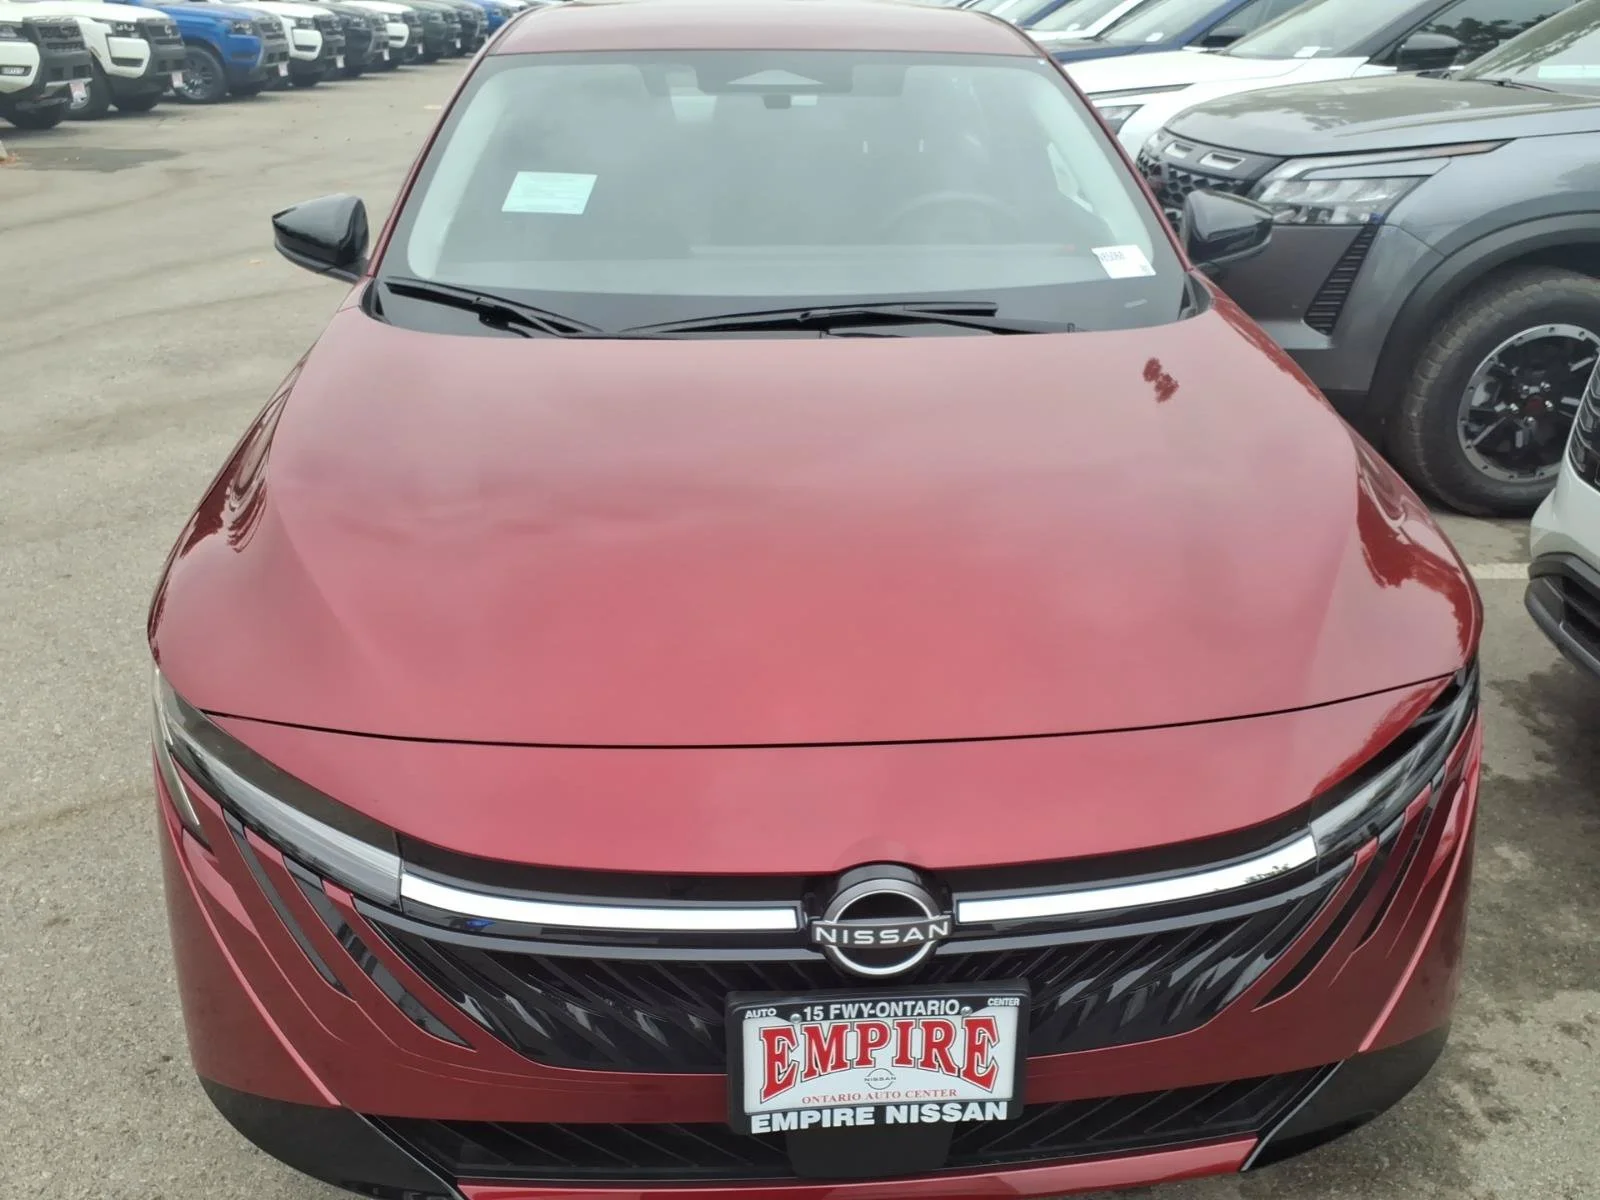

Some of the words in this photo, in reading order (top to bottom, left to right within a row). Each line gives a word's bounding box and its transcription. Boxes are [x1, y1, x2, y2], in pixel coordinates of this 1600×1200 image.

[816, 921, 949, 944] NISSAN
[804, 1006, 824, 1021] 15
[829, 999, 960, 1019] FWY-ONTARIO
[987, 997, 1020, 1007] CENTER
[745, 1008, 777, 1019] AUTO
[760, 1016, 1000, 1104] EMPIRE
[802, 1092, 861, 1104] ONTARIO
[866, 1090, 901, 1100] AUTO
[905, 1089, 957, 1099] CENTER
[751, 1106, 875, 1134] EMPIRE
[886, 1101, 1008, 1124] NISSAN
